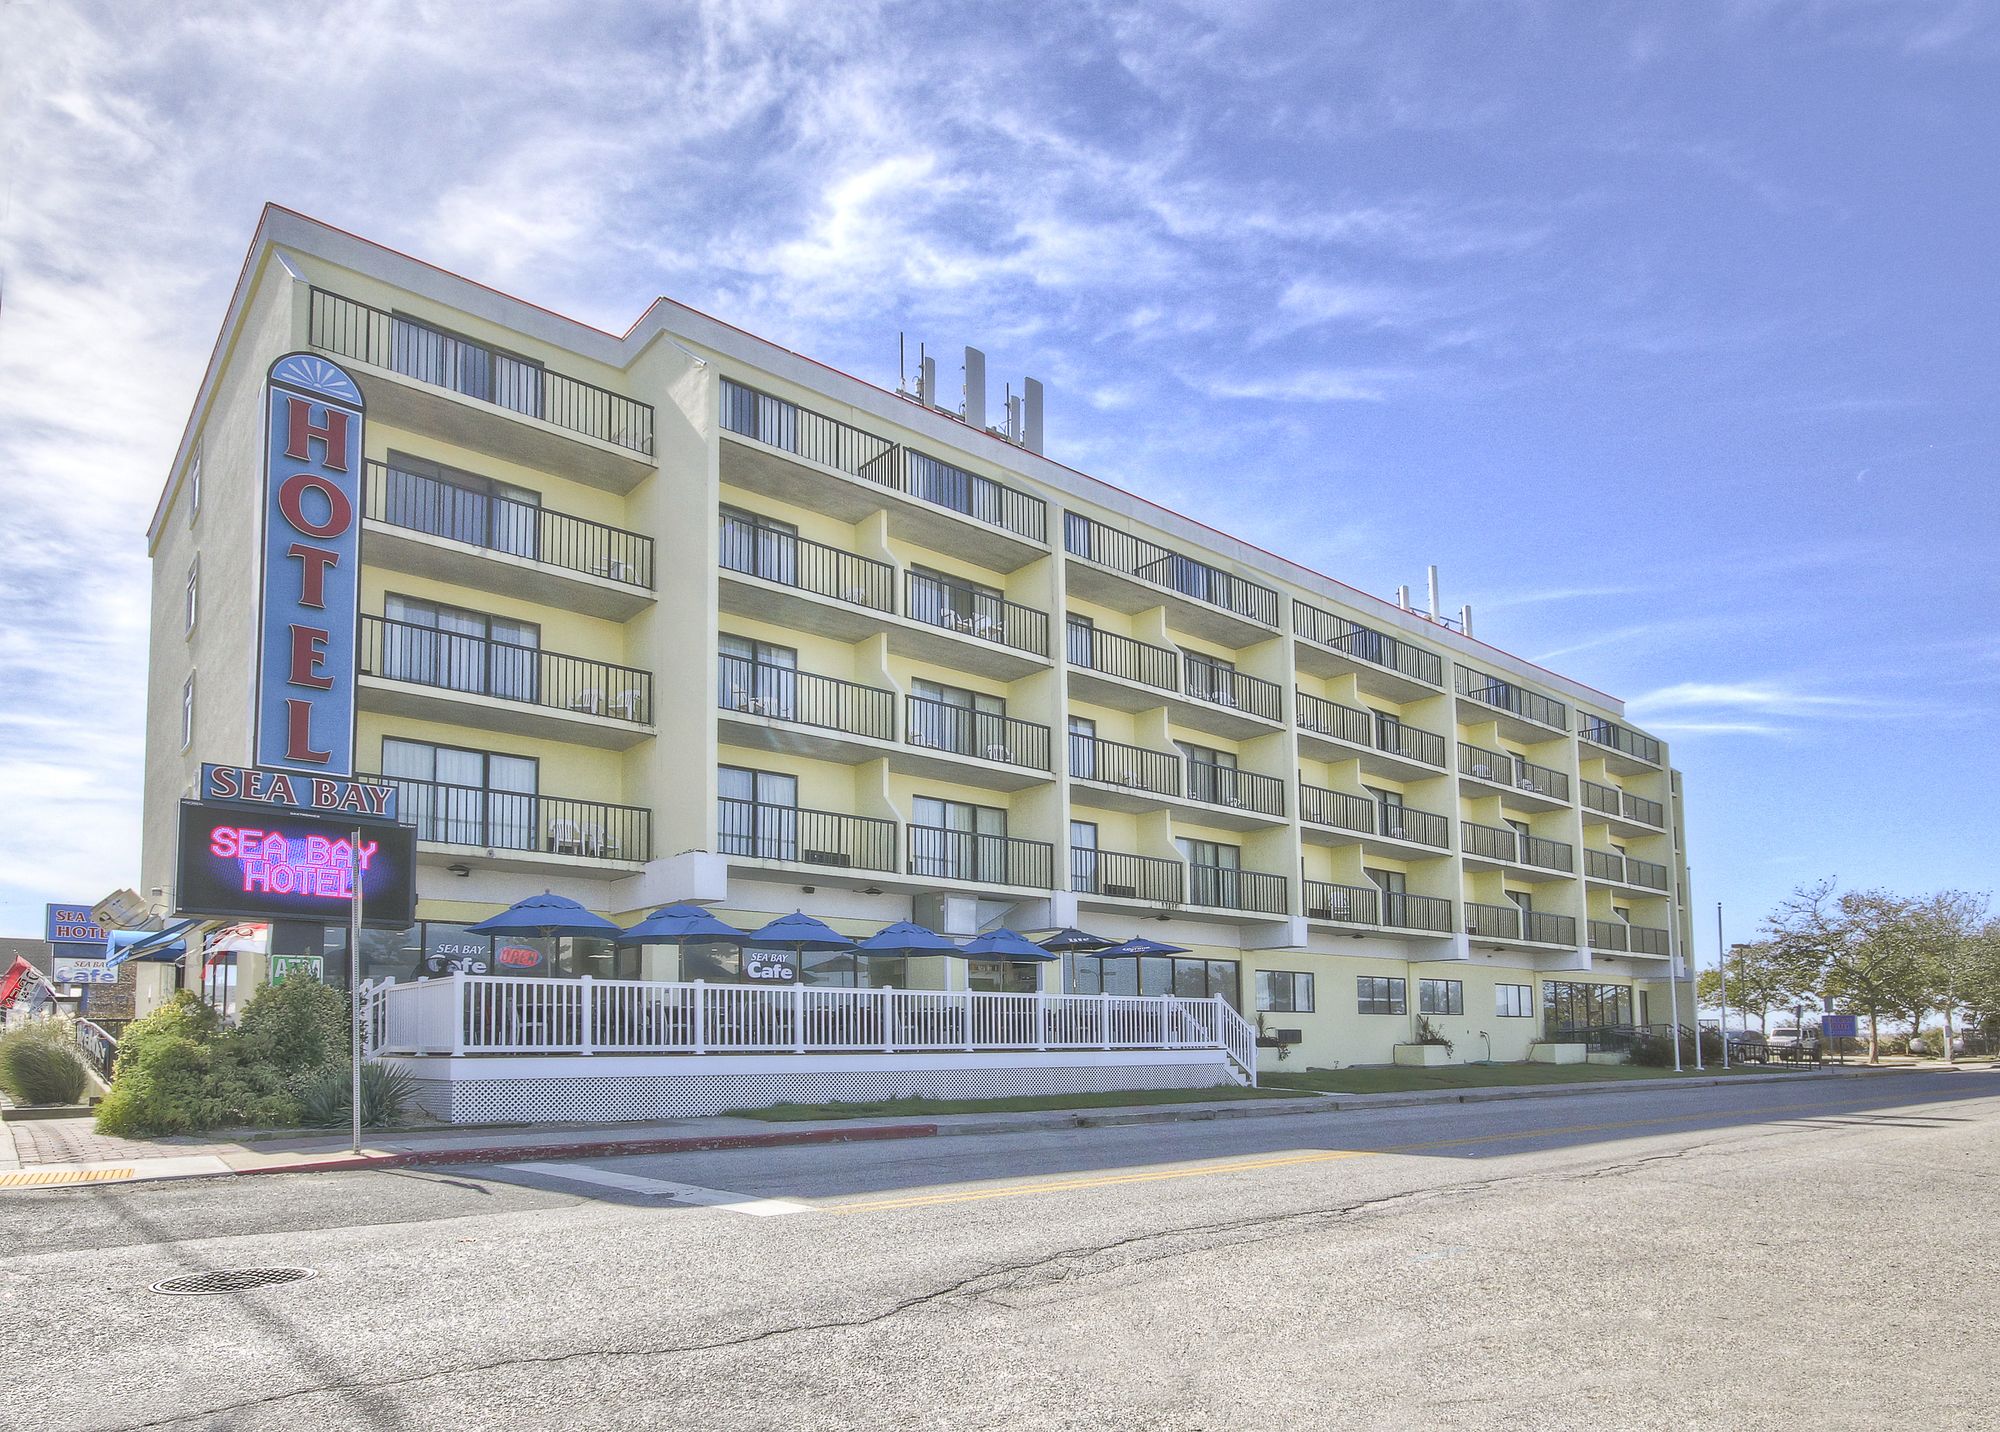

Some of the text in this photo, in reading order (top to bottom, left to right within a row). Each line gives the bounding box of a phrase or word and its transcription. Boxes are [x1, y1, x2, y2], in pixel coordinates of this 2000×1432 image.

[279, 396, 352, 765] HOTEL
[210, 766, 393, 815] SEA BAY
[210, 826, 378, 870] SEA BAY
[243, 862, 363, 900] HOTEL
[56, 910, 86, 923] SEA
[56, 925, 108, 938] HOTE
[437, 944, 485, 955] SEA BAY
[751, 952, 788, 963] SEA BAY
[56, 965, 115, 982] Cafe
[275, 959, 320, 978] ATM
[747, 961, 793, 980] Cafe
